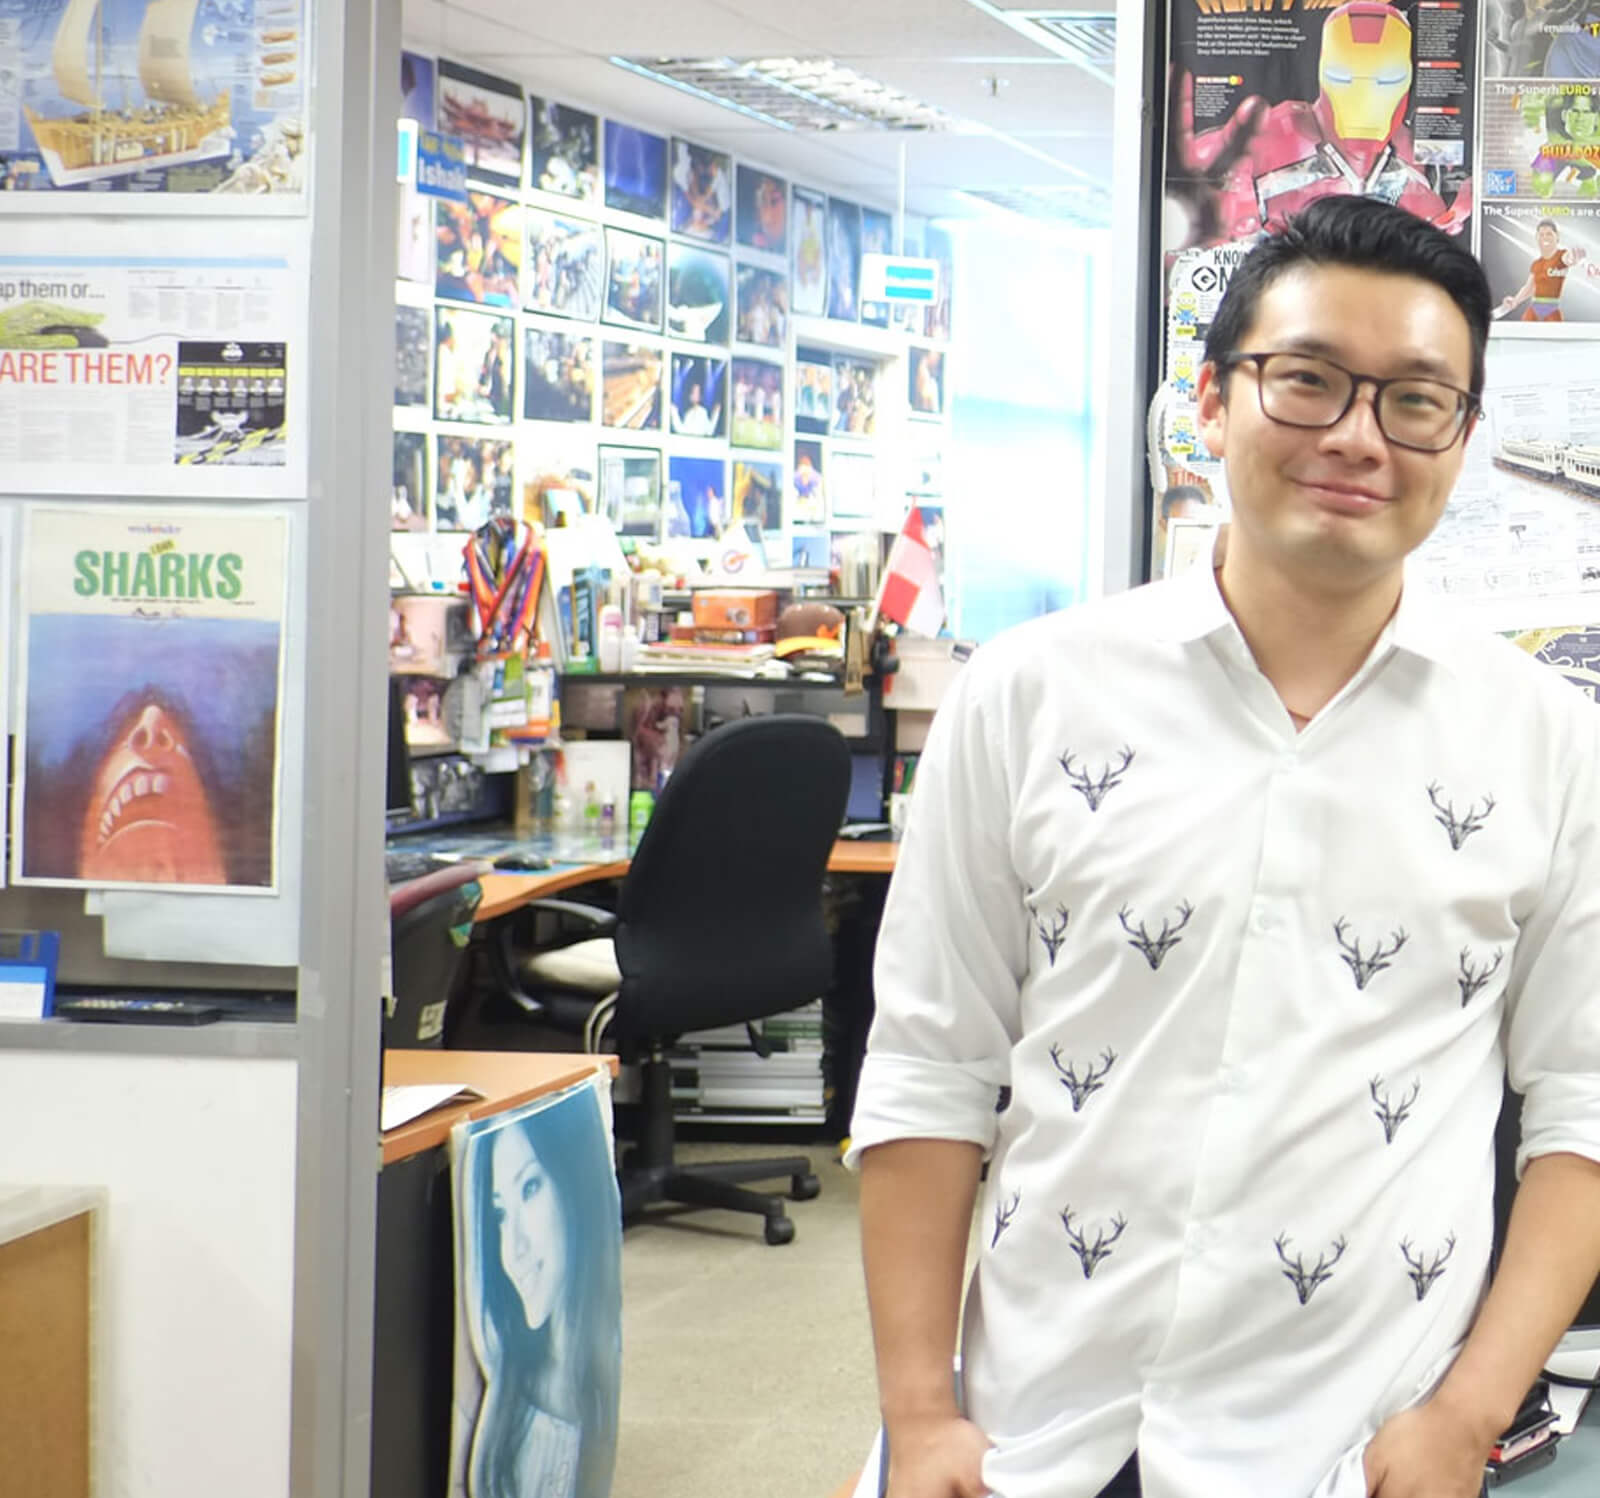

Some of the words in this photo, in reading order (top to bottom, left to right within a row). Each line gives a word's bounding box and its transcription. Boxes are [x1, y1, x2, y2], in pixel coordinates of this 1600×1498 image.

[1495, 84, 1516, 96] The
[1483, 205, 1501, 217] The
[1577, 208, 1594, 218] are
[19, 279, 68, 298] them
[0, 351, 58, 384] ARE
[64, 352, 172, 385] THEM?
[74, 550, 243, 600] SHARKS
